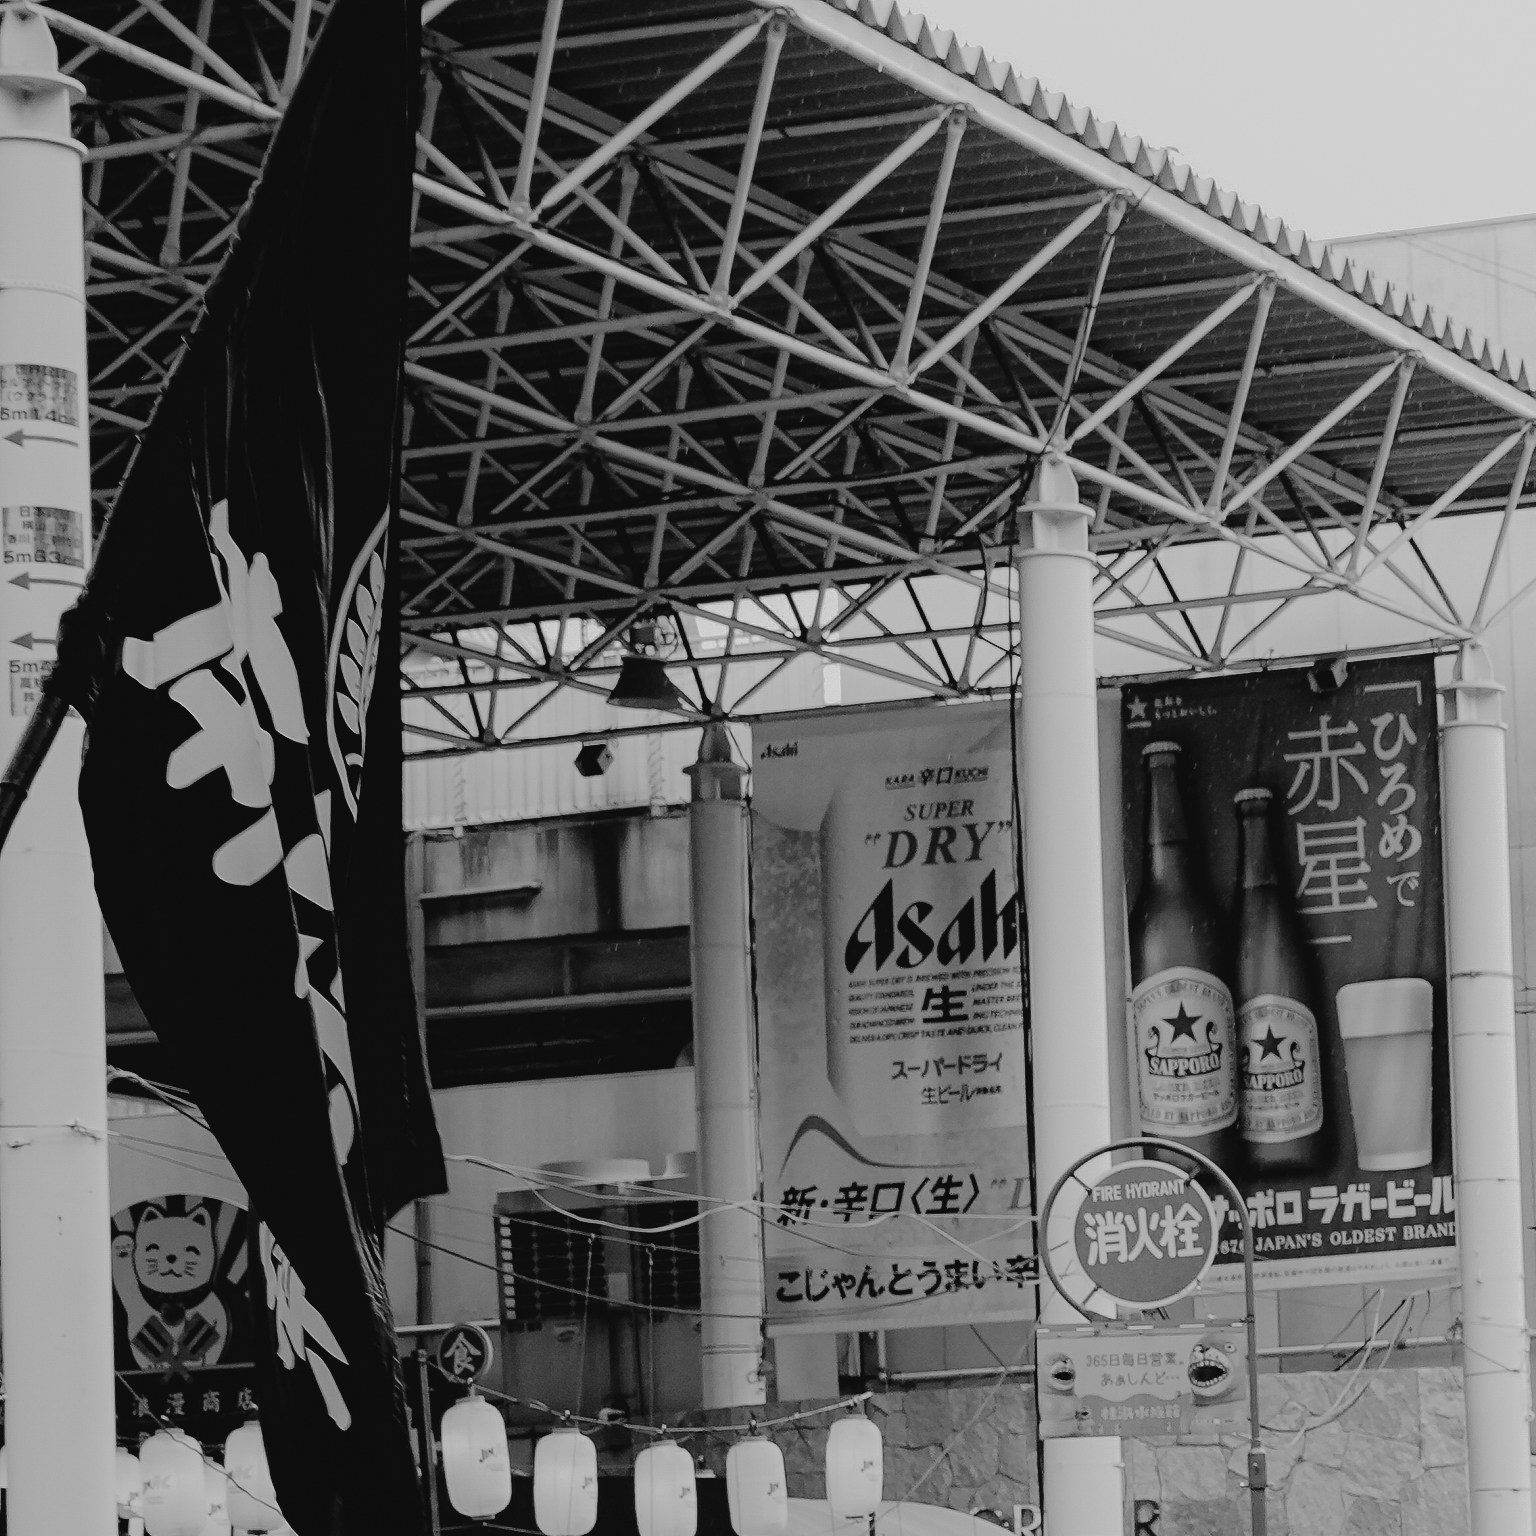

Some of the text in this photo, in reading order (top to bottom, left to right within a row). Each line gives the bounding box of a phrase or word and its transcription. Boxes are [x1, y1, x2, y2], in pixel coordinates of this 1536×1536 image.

[904, 799, 974, 821] SUPER
[921, 985, 969, 1023] 生
[892, 1052, 1002, 1080] スーパードライ
[1150, 1052, 1220, 1077] SAPPORO
[1092, 1179, 1185, 1202] FIRE HYDRANT
[1084, 1203, 1204, 1266] 消火栓
[1255, 1232, 1323, 1251] JAPAN'S
[1329, 1226, 1397, 1247] OLDEST
[445, 1333, 481, 1374] 食
